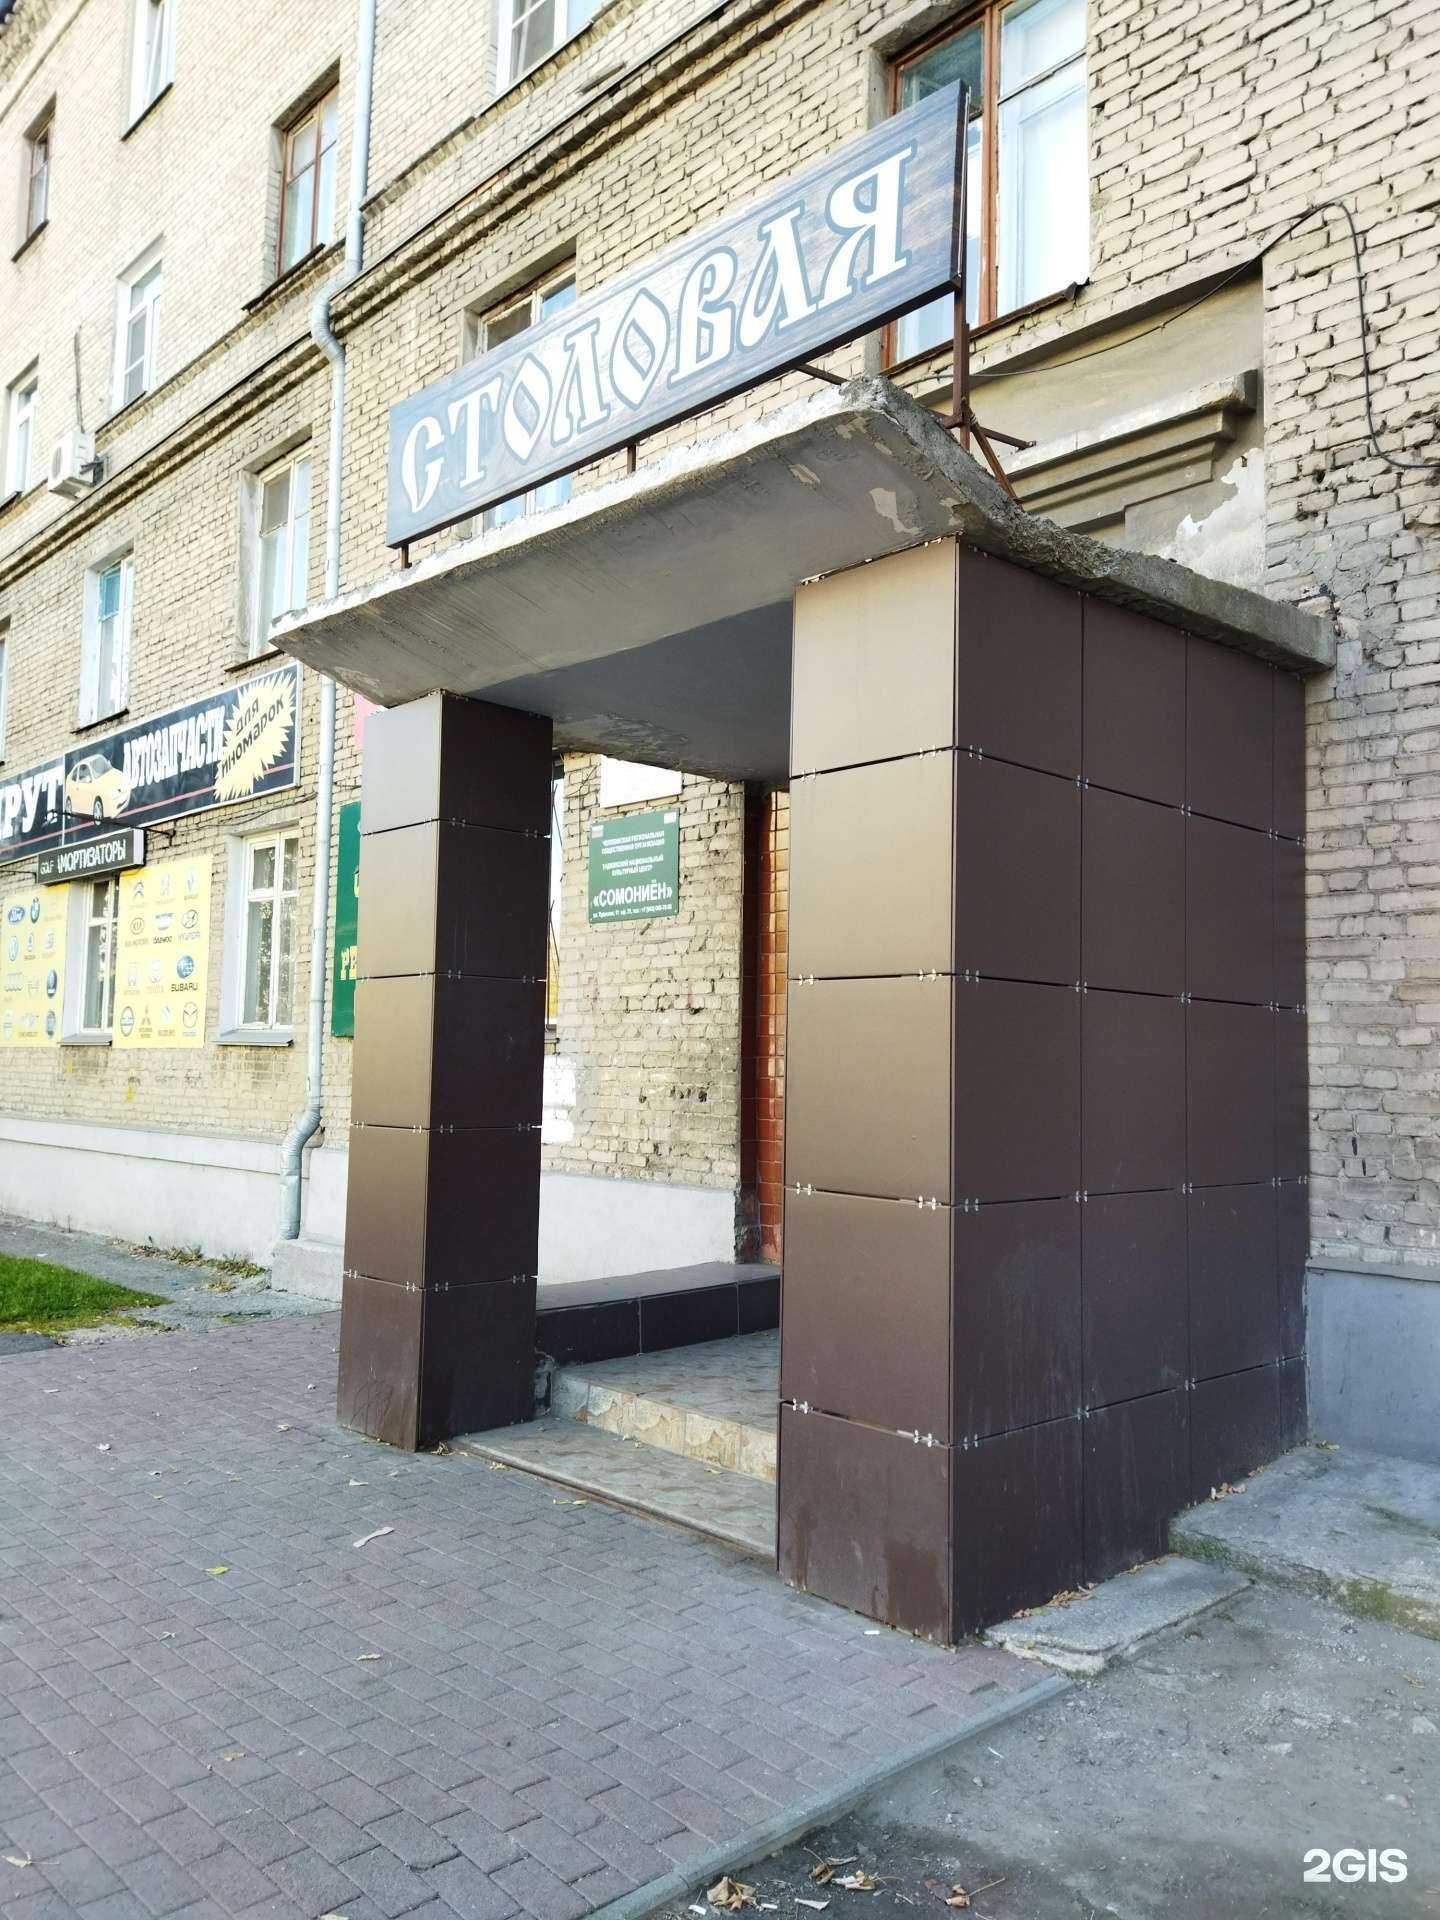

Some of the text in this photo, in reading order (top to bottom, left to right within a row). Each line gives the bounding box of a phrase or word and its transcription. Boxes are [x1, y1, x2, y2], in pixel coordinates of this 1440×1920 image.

[399, 146, 914, 513] СТОЛОВАЯ
[122, 705, 225, 789] АВТОЗАПЧАСТИ
[222, 695, 284, 777] ИНОМАРОК
[236, 697, 259, 735] ДЛЯ
[0, 765, 64, 839] РУТ
[593, 879, 673, 907] «СОМОНИЁН»
[171, 983, 198, 992] SUBARU
